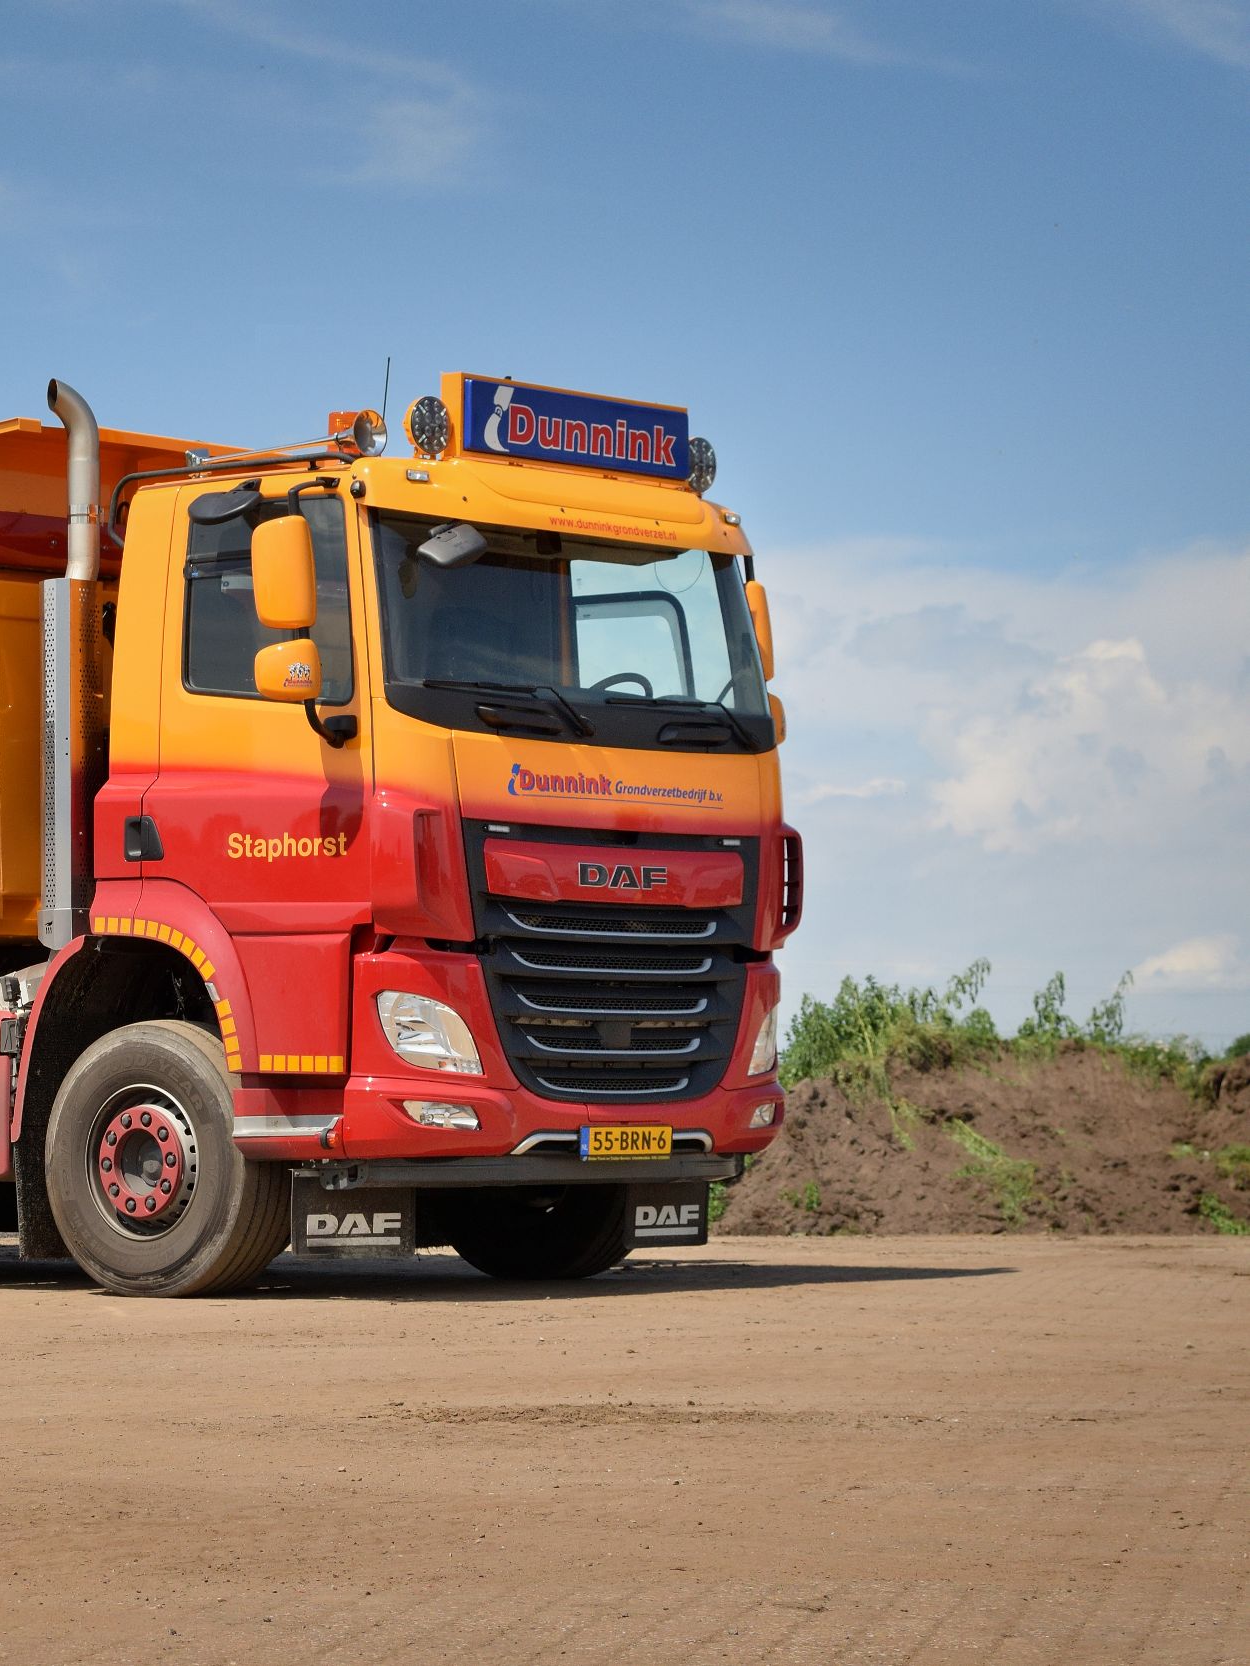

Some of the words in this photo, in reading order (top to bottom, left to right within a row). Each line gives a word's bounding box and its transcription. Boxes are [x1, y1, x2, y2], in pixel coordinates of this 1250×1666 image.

[508, 403, 676, 467] Dunnink
[549, 517, 677, 540] www.dunninkgrondverzet.nl
[519, 769, 612, 796] Dunnink
[615, 780, 707, 803] Grondverzetbedrijf
[709, 790, 723, 802] b.v.
[227, 832, 347, 863] Staphorst
[578, 862, 668, 890] DAF
[593, 1130, 667, 1151] 55-BRN-6
[306, 1212, 402, 1236] DAF
[635, 1204, 700, 1227] DAF
